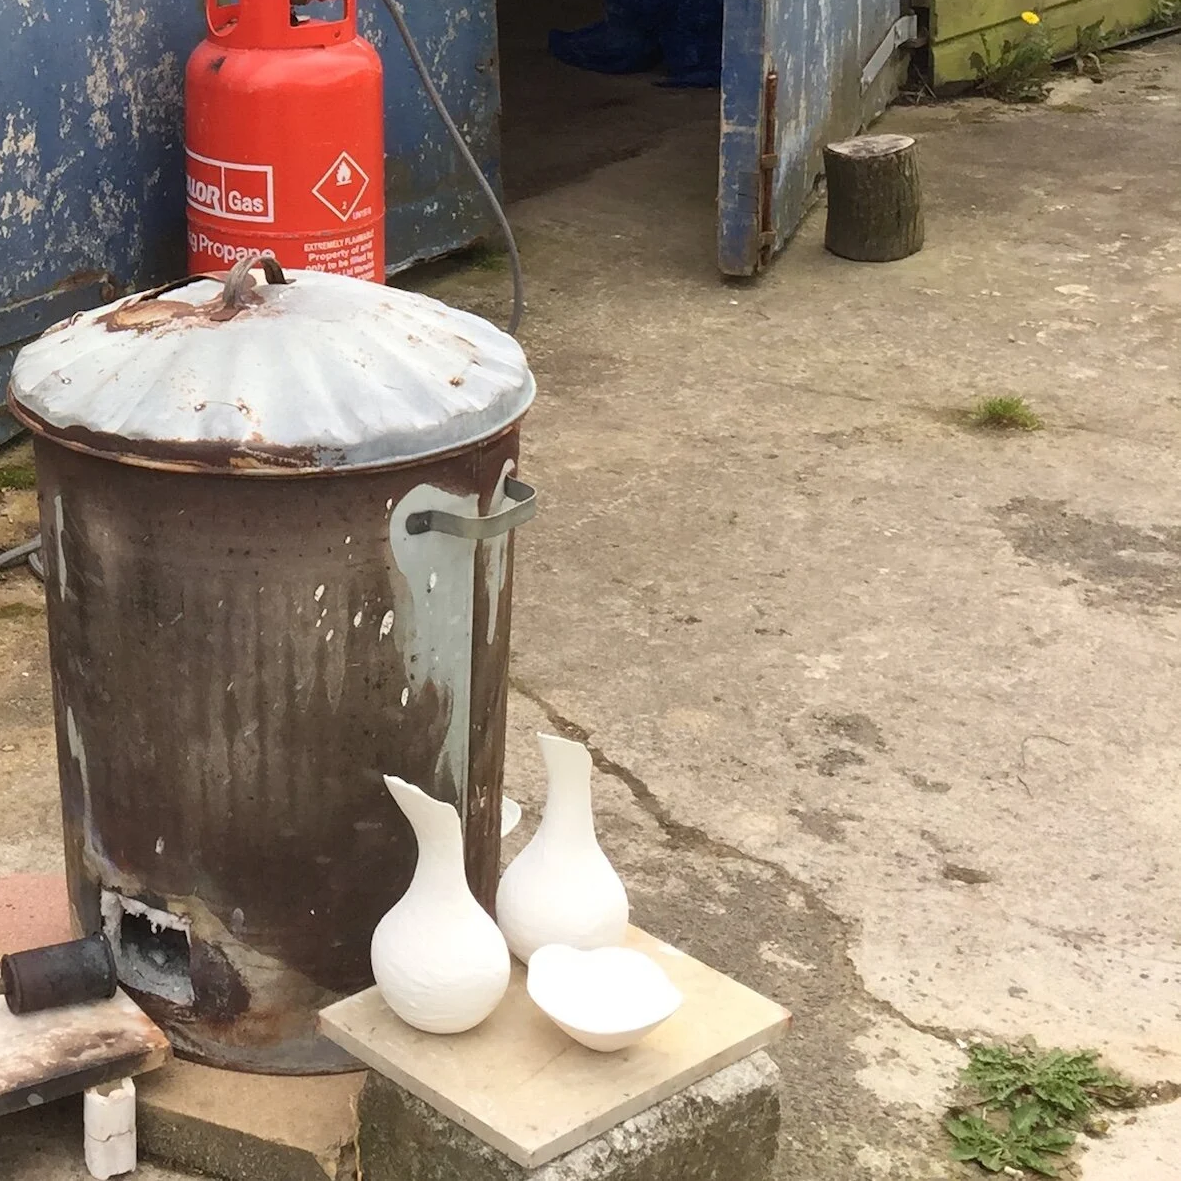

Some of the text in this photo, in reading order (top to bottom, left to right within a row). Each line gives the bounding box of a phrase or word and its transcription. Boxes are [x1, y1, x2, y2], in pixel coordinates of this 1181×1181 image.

[228, 190, 264, 212] Gas
[199, 233, 276, 263] Propane
[304, 239, 344, 252] EXTREMELY
[308, 249, 349, 262] Property
[350, 244, 359, 254] of
[305, 263, 326, 272] only
[327, 262, 337, 270] to
[338, 259, 349, 268] be
